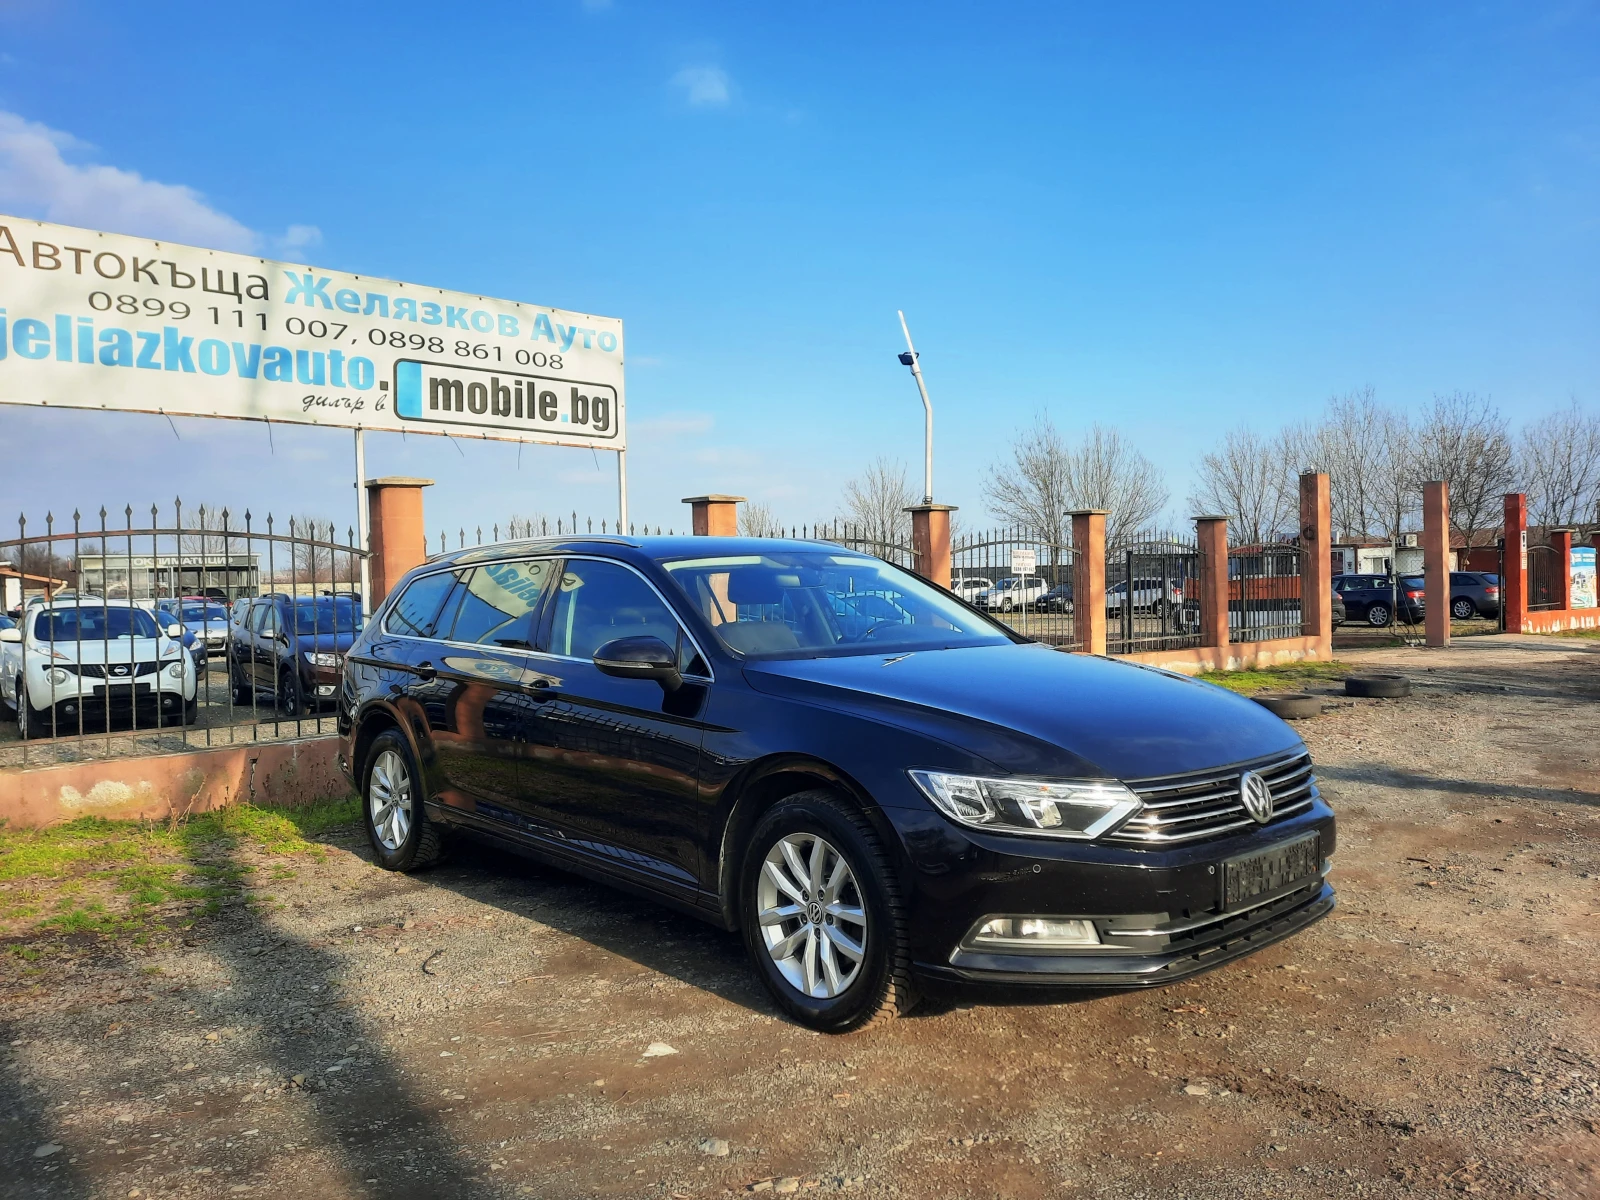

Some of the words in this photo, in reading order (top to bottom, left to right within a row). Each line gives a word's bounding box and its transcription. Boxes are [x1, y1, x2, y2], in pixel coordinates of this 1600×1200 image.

[88, 291, 191, 320] 0899
[208, 306, 267, 331] 111
[368, 328, 445, 353] 0898
[454, 340, 503, 362] 861
[515, 349, 564, 370] 008
[283, 270, 520, 338] Желязков
[530, 312, 618, 353] Ауто
[429, 375, 610, 432] mobile.bg
